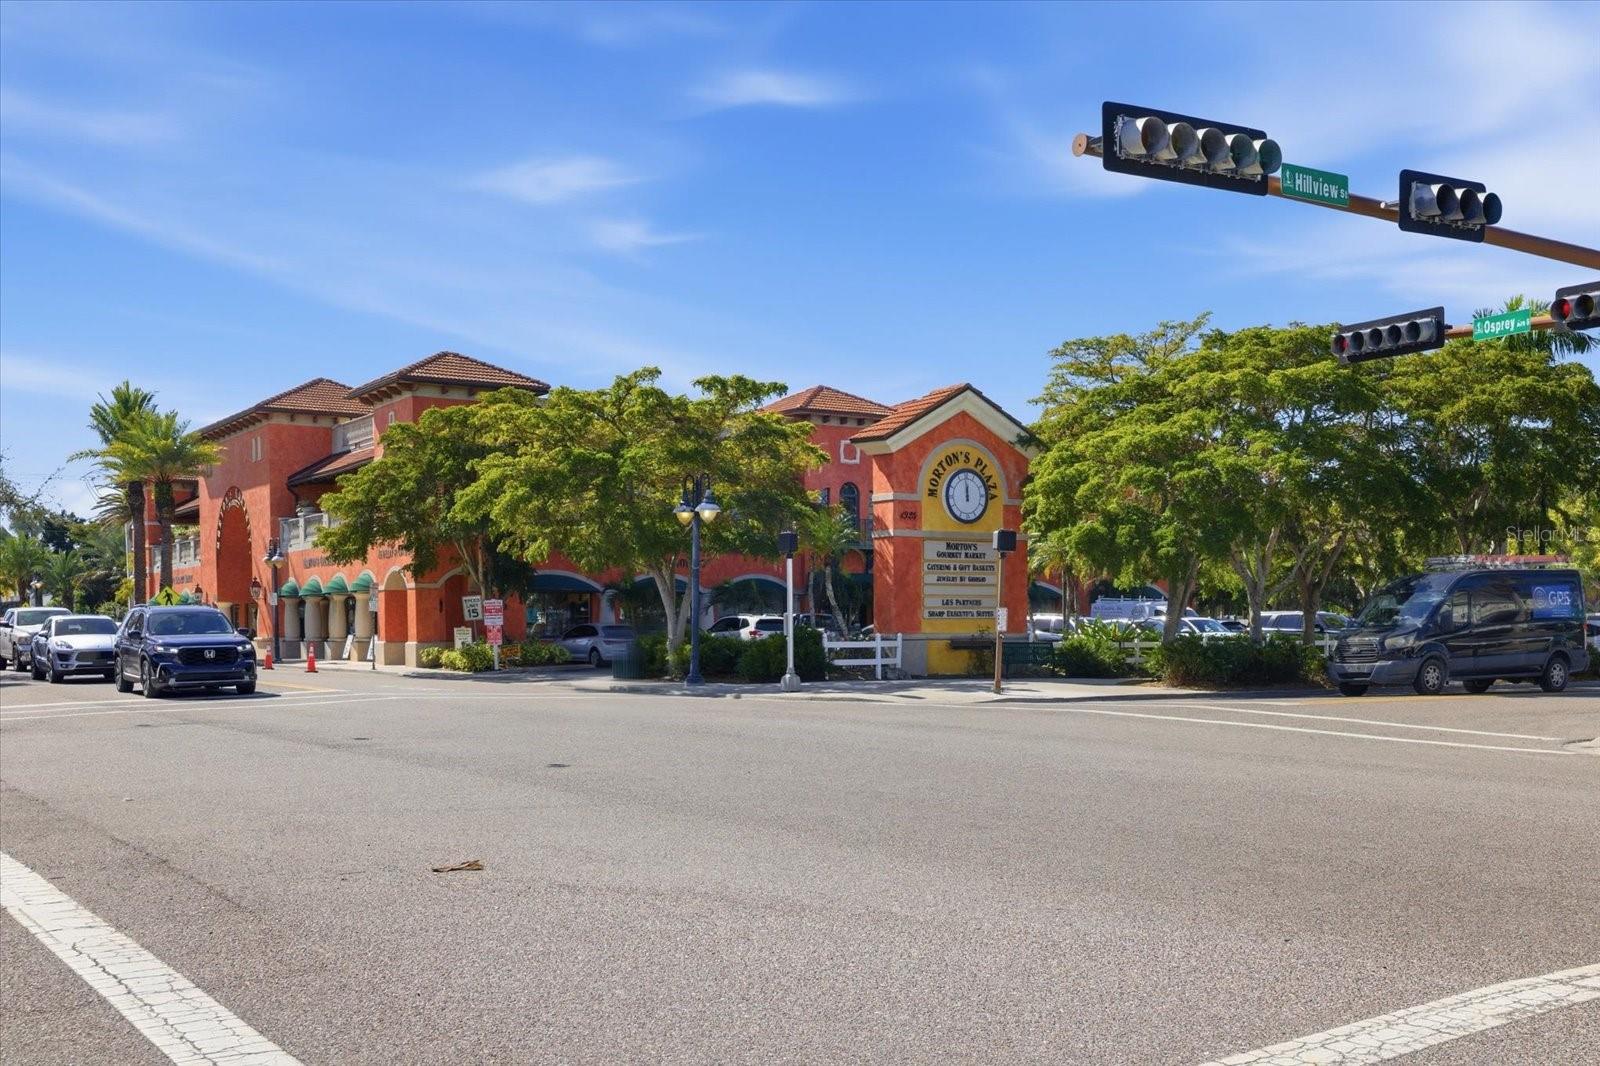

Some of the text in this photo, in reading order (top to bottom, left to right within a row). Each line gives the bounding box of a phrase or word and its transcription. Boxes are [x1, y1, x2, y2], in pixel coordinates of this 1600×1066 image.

[1295, 172, 1348, 199] Hillview St
[1484, 318, 1515, 334] Osprey
[928, 451, 970, 498] MORTON'S
[975, 458, 998, 501] PLAZA
[946, 542, 978, 551] MORTON'S
[936, 551, 962, 559] GOURMET
[467, 608, 480, 618] 15
